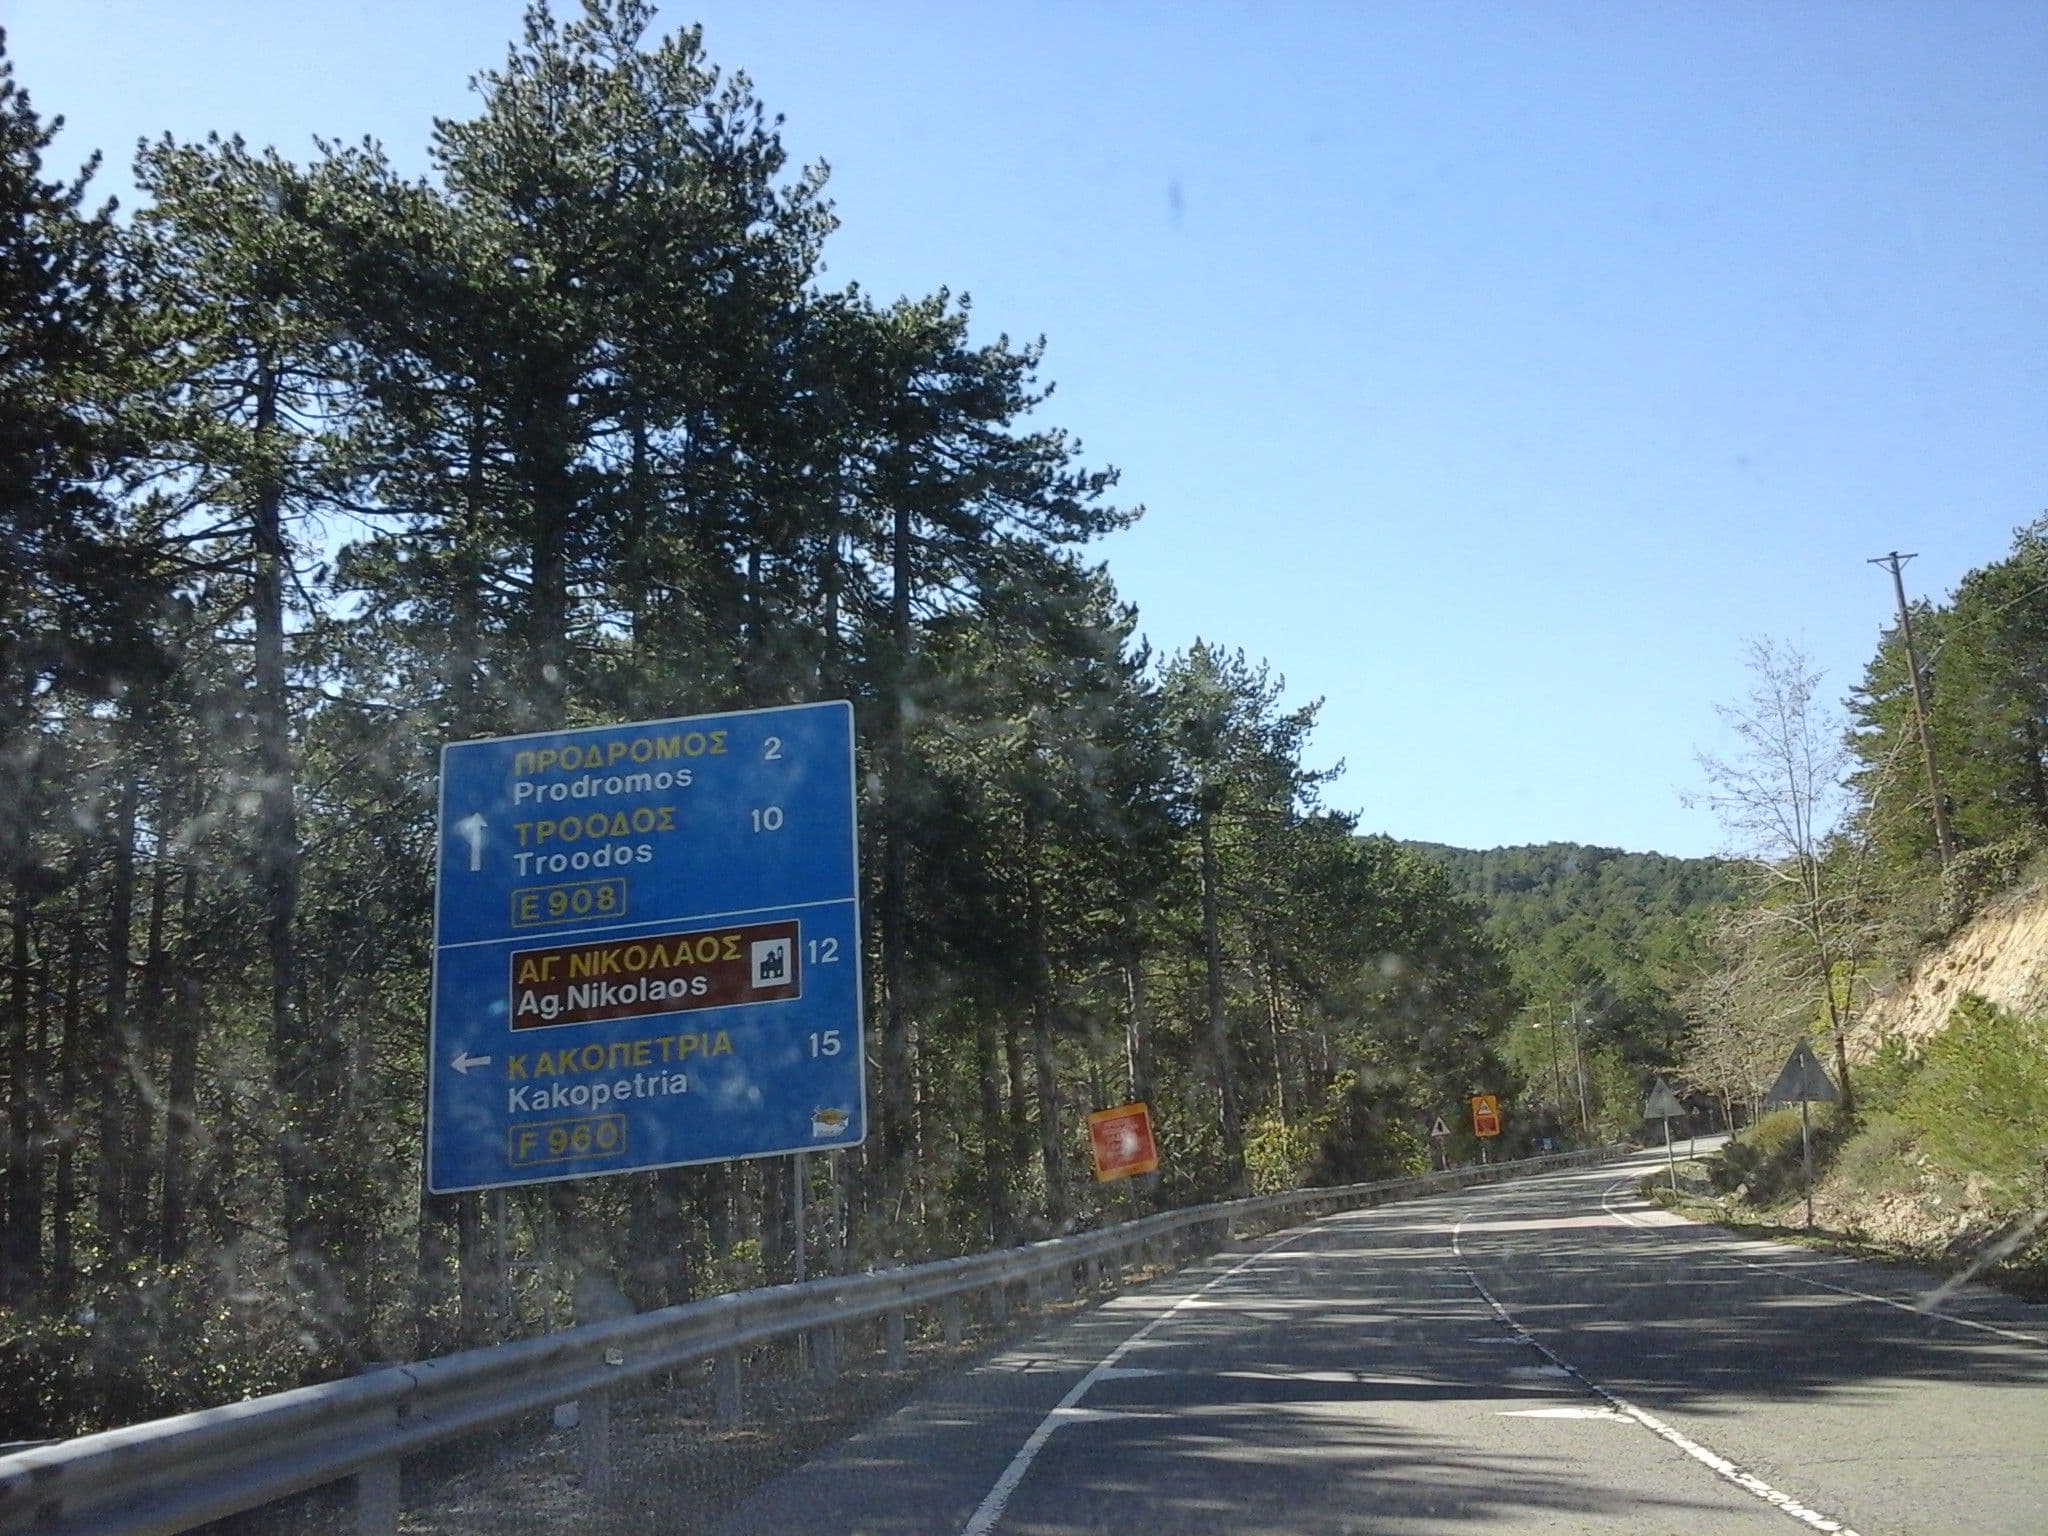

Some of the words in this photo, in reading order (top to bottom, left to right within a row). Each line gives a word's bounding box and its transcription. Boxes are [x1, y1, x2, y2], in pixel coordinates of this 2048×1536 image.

[514, 731, 728, 775] ΠΡΟΔΡΟΜΟΣ
[764, 737, 783, 760] 2
[512, 766, 693, 806] Prodromos
[514, 807, 676, 847] ΤΡΟΟΔΟΣ
[752, 806, 784, 832] 10
[514, 841, 654, 877] Troodos
[520, 896, 539, 921] E
[549, 886, 615, 916] 908
[569, 934, 743, 978] ΝΙΚΟΛΑΟΣ
[808, 937, 839, 964] 12
[508, 1031, 733, 1079] ΚΑΚΟΠΕΤΡΙΑ
[809, 1029, 842, 1057] 15
[507, 1070, 688, 1112] Kakopetria
[518, 1131, 538, 1157] F
[548, 1121, 618, 1153] 960
